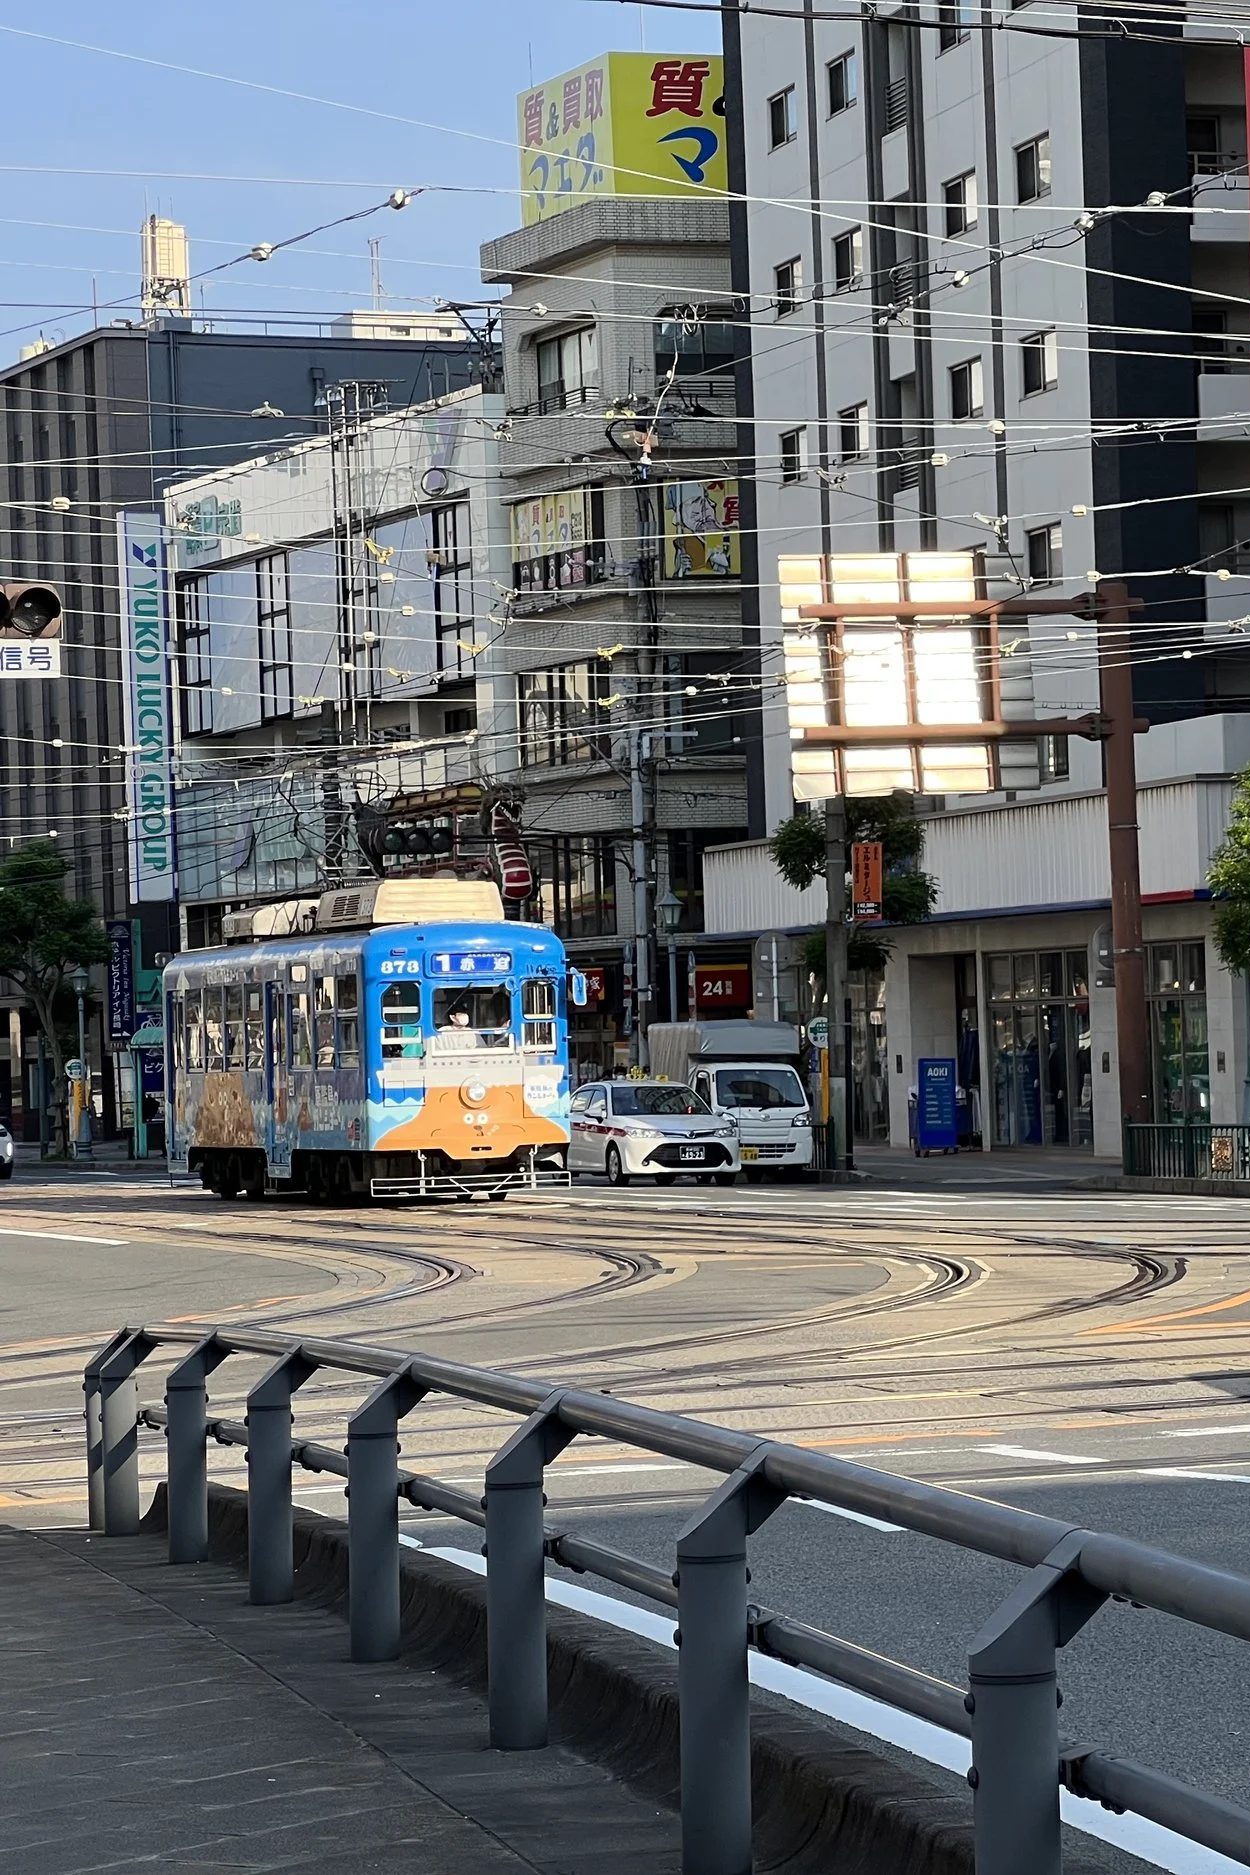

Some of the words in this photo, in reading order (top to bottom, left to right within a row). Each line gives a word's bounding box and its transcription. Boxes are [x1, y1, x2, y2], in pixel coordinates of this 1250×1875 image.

[646, 60, 726, 118] 質
[528, 131, 604, 211] マエダ
[656, 126, 719, 183] マ
[133, 579, 161, 664] YUKO
[0, 646, 53, 671] 信号
[137, 673, 164, 769] LUCKY
[140, 773, 167, 872] GROUP
[435, 954, 450, 973] 1
[702, 980, 723, 996] 24
[927, 1067, 948, 1077] AOKI
